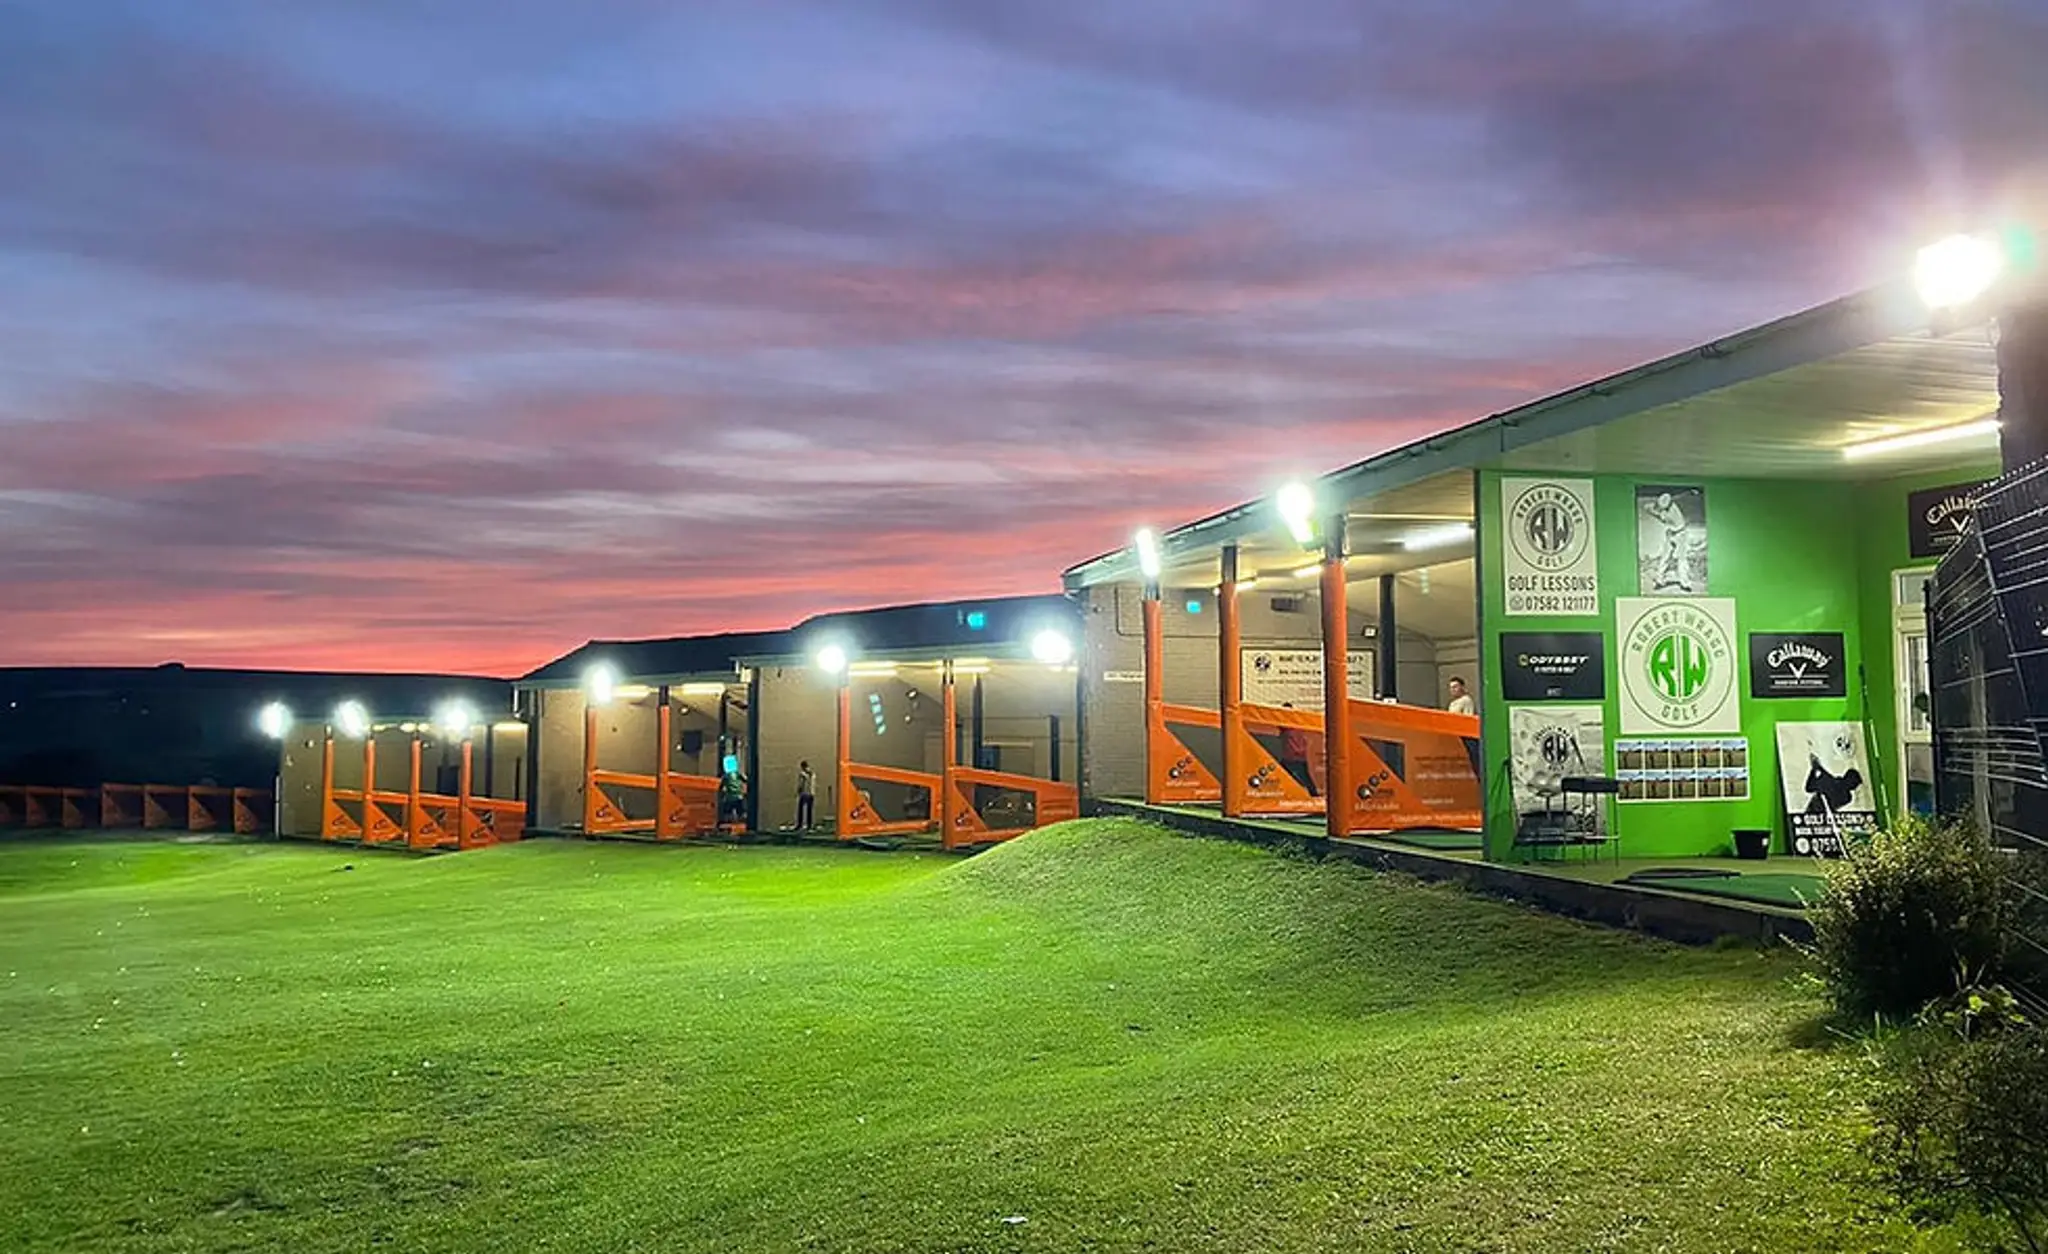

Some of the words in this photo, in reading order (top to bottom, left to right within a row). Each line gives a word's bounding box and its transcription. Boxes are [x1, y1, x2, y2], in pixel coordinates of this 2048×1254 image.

[1508, 576, 1539, 591] GOLF
[1541, 576, 1595, 591] LESSONS
[1525, 596, 1560, 611] 07582
[1562, 596, 1596, 611] 121177
[1631, 609, 1679, 653] ROBERT
[1683, 611, 1725, 659] WRAGG
[1529, 655, 1588, 664] ODYSSEY
[1767, 641, 1833, 668] Callaway
[1650, 634, 1707, 698] RW
[1660, 703, 1699, 721] GOLF
